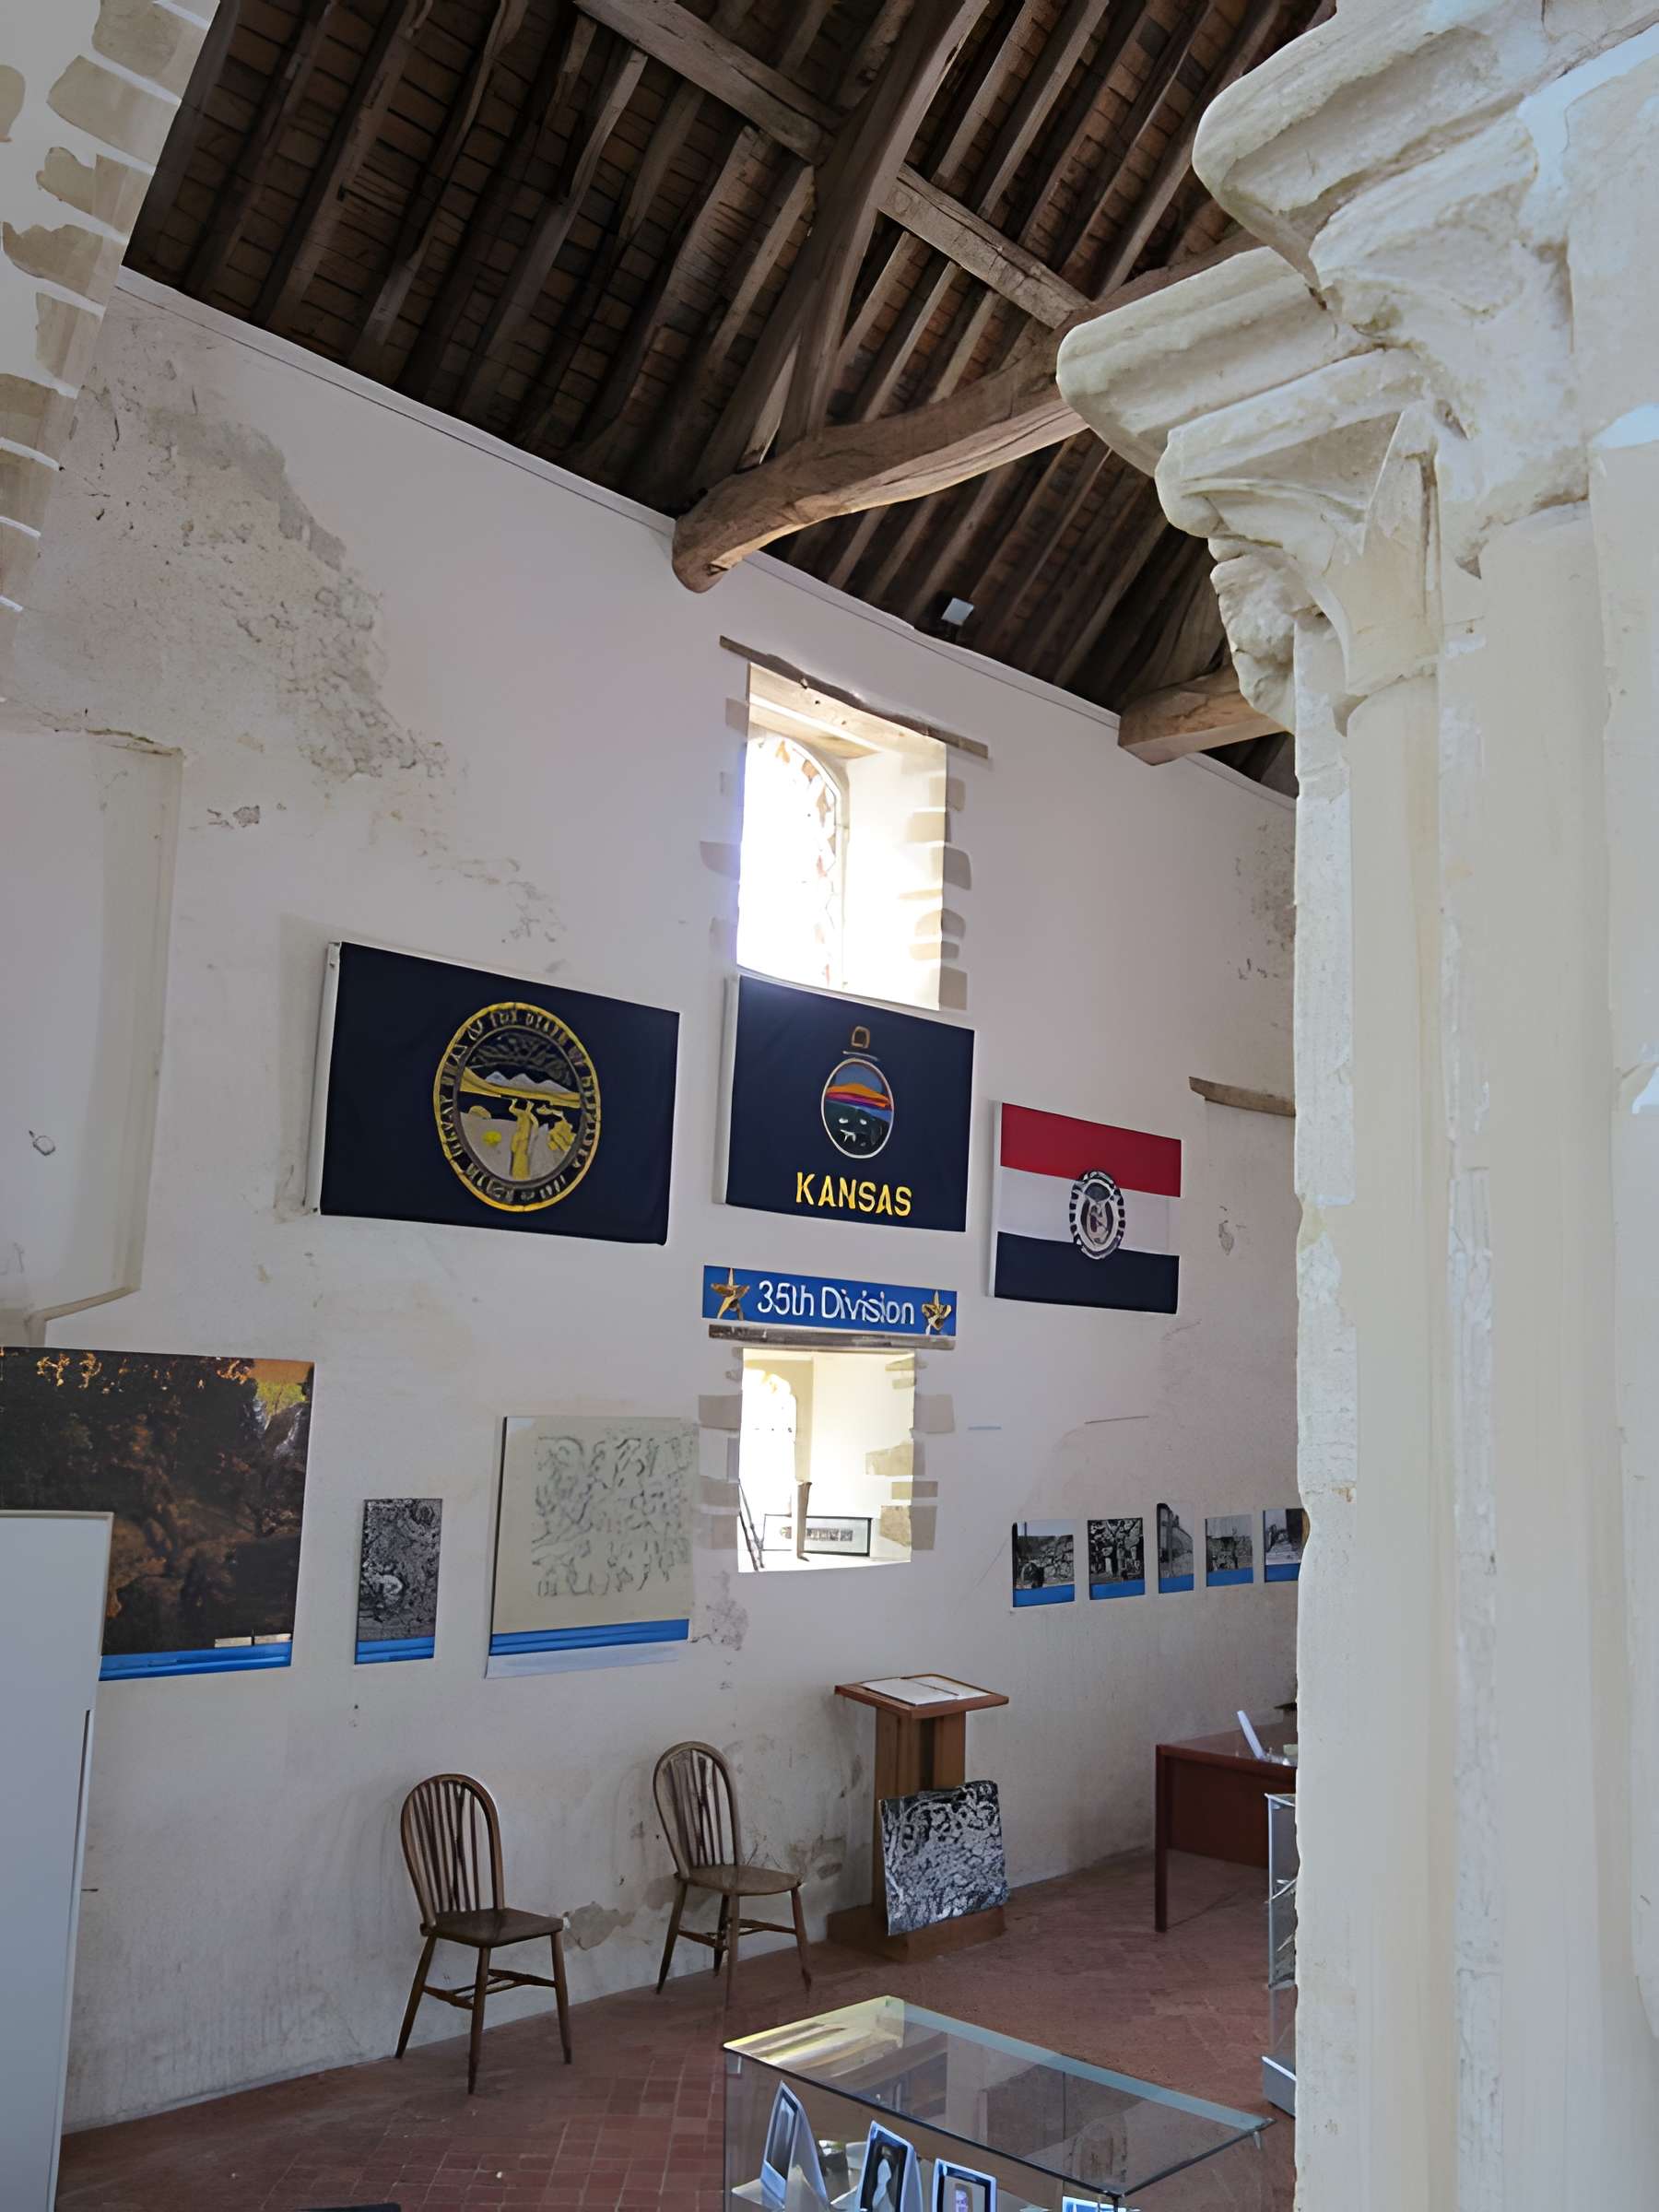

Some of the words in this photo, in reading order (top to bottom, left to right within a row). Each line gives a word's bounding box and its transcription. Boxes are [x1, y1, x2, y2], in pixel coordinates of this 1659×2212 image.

[795, 1171, 912, 1217] KANSAS
[757, 1279, 815, 1316] 35th
[821, 1285, 915, 1324] Division
